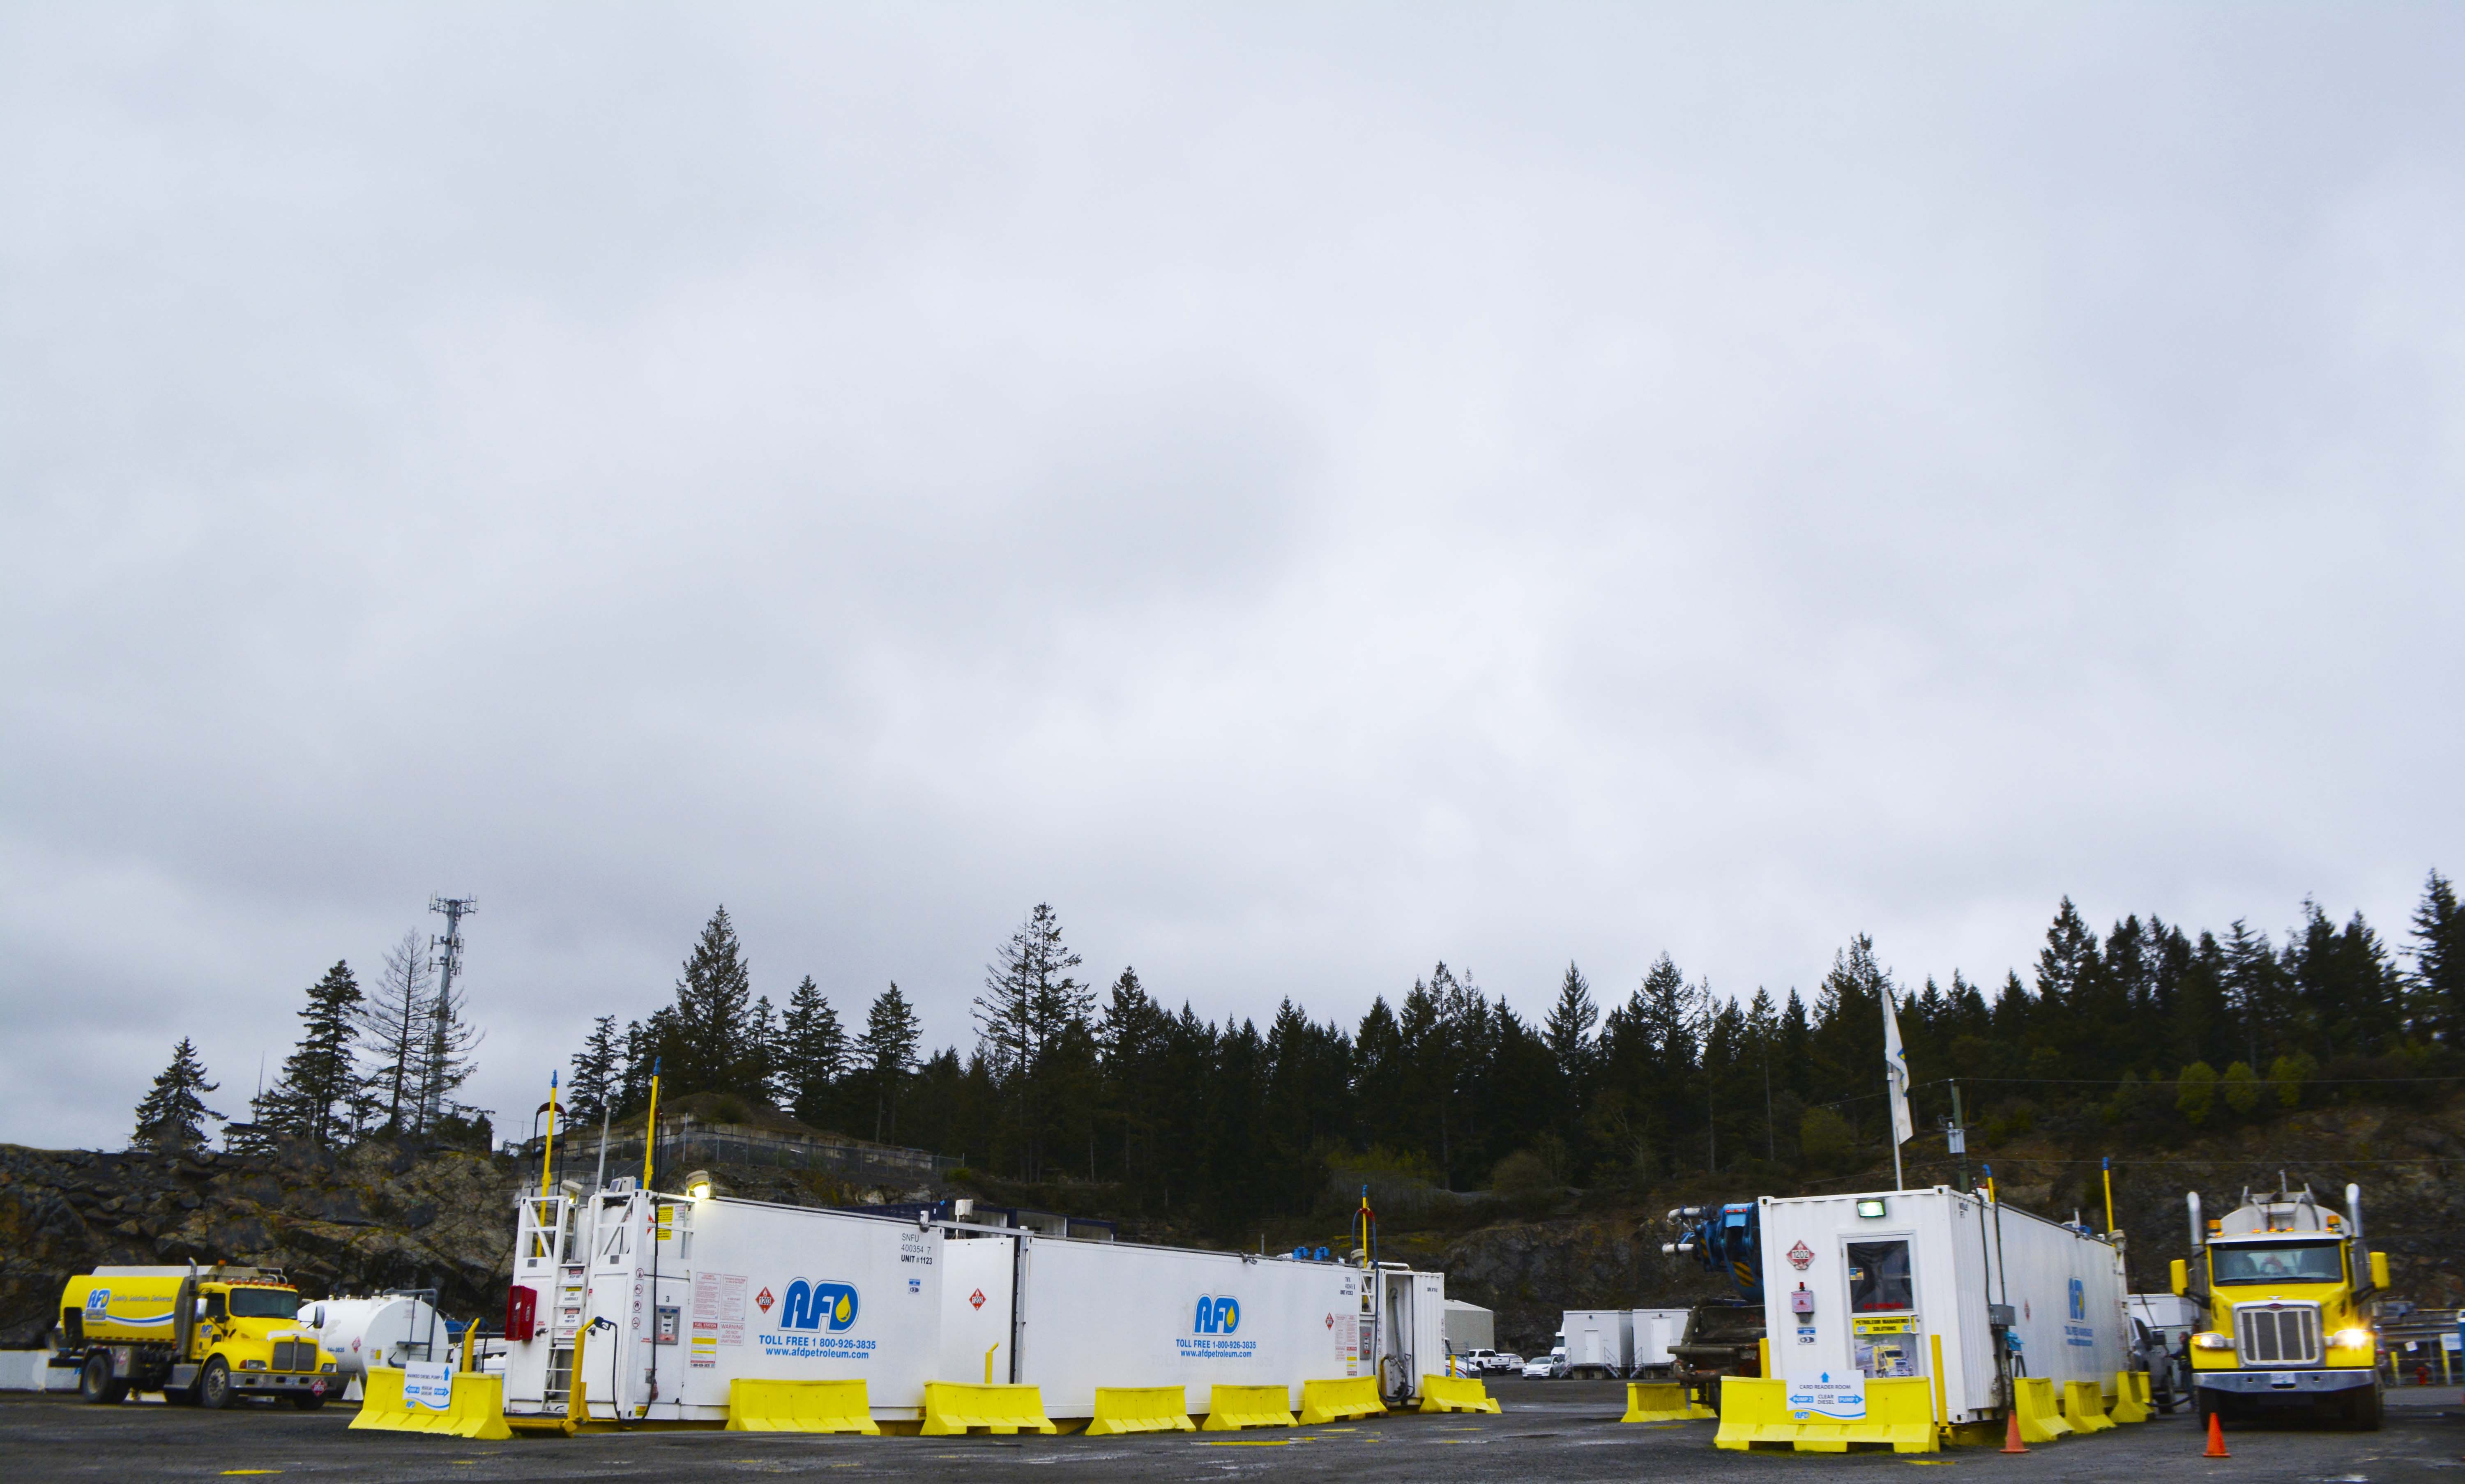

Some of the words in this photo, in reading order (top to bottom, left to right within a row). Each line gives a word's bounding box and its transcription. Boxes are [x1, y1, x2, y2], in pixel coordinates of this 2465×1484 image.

[902, 1233, 919, 1242] SNFU
[901, 1244, 924, 1253] 400354
[901, 1254, 915, 1263] UNIT
[916, 1256, 933, 1265] #1123
[760, 1297, 771, 1305] 1203
[780, 1279, 859, 1331] AFD
[1194, 1296, 1240, 1334] AFD
[759, 1335, 783, 1345] TOLL
[786, 1336, 809, 1346] FREE
[812, 1337, 816, 1346] 1
[820, 1338, 876, 1349] 800-926-3835
[1176, 1339, 1192, 1348] TOLL
[1193, 1339, 1211, 1348] FREE
[1212, 1341, 1256, 1349] 1-800-926-3835
[765, 1346, 869, 1359] www.afdpetroleum.com
[1180, 1349, 1252, 1359] www.afdpetroleum.com
